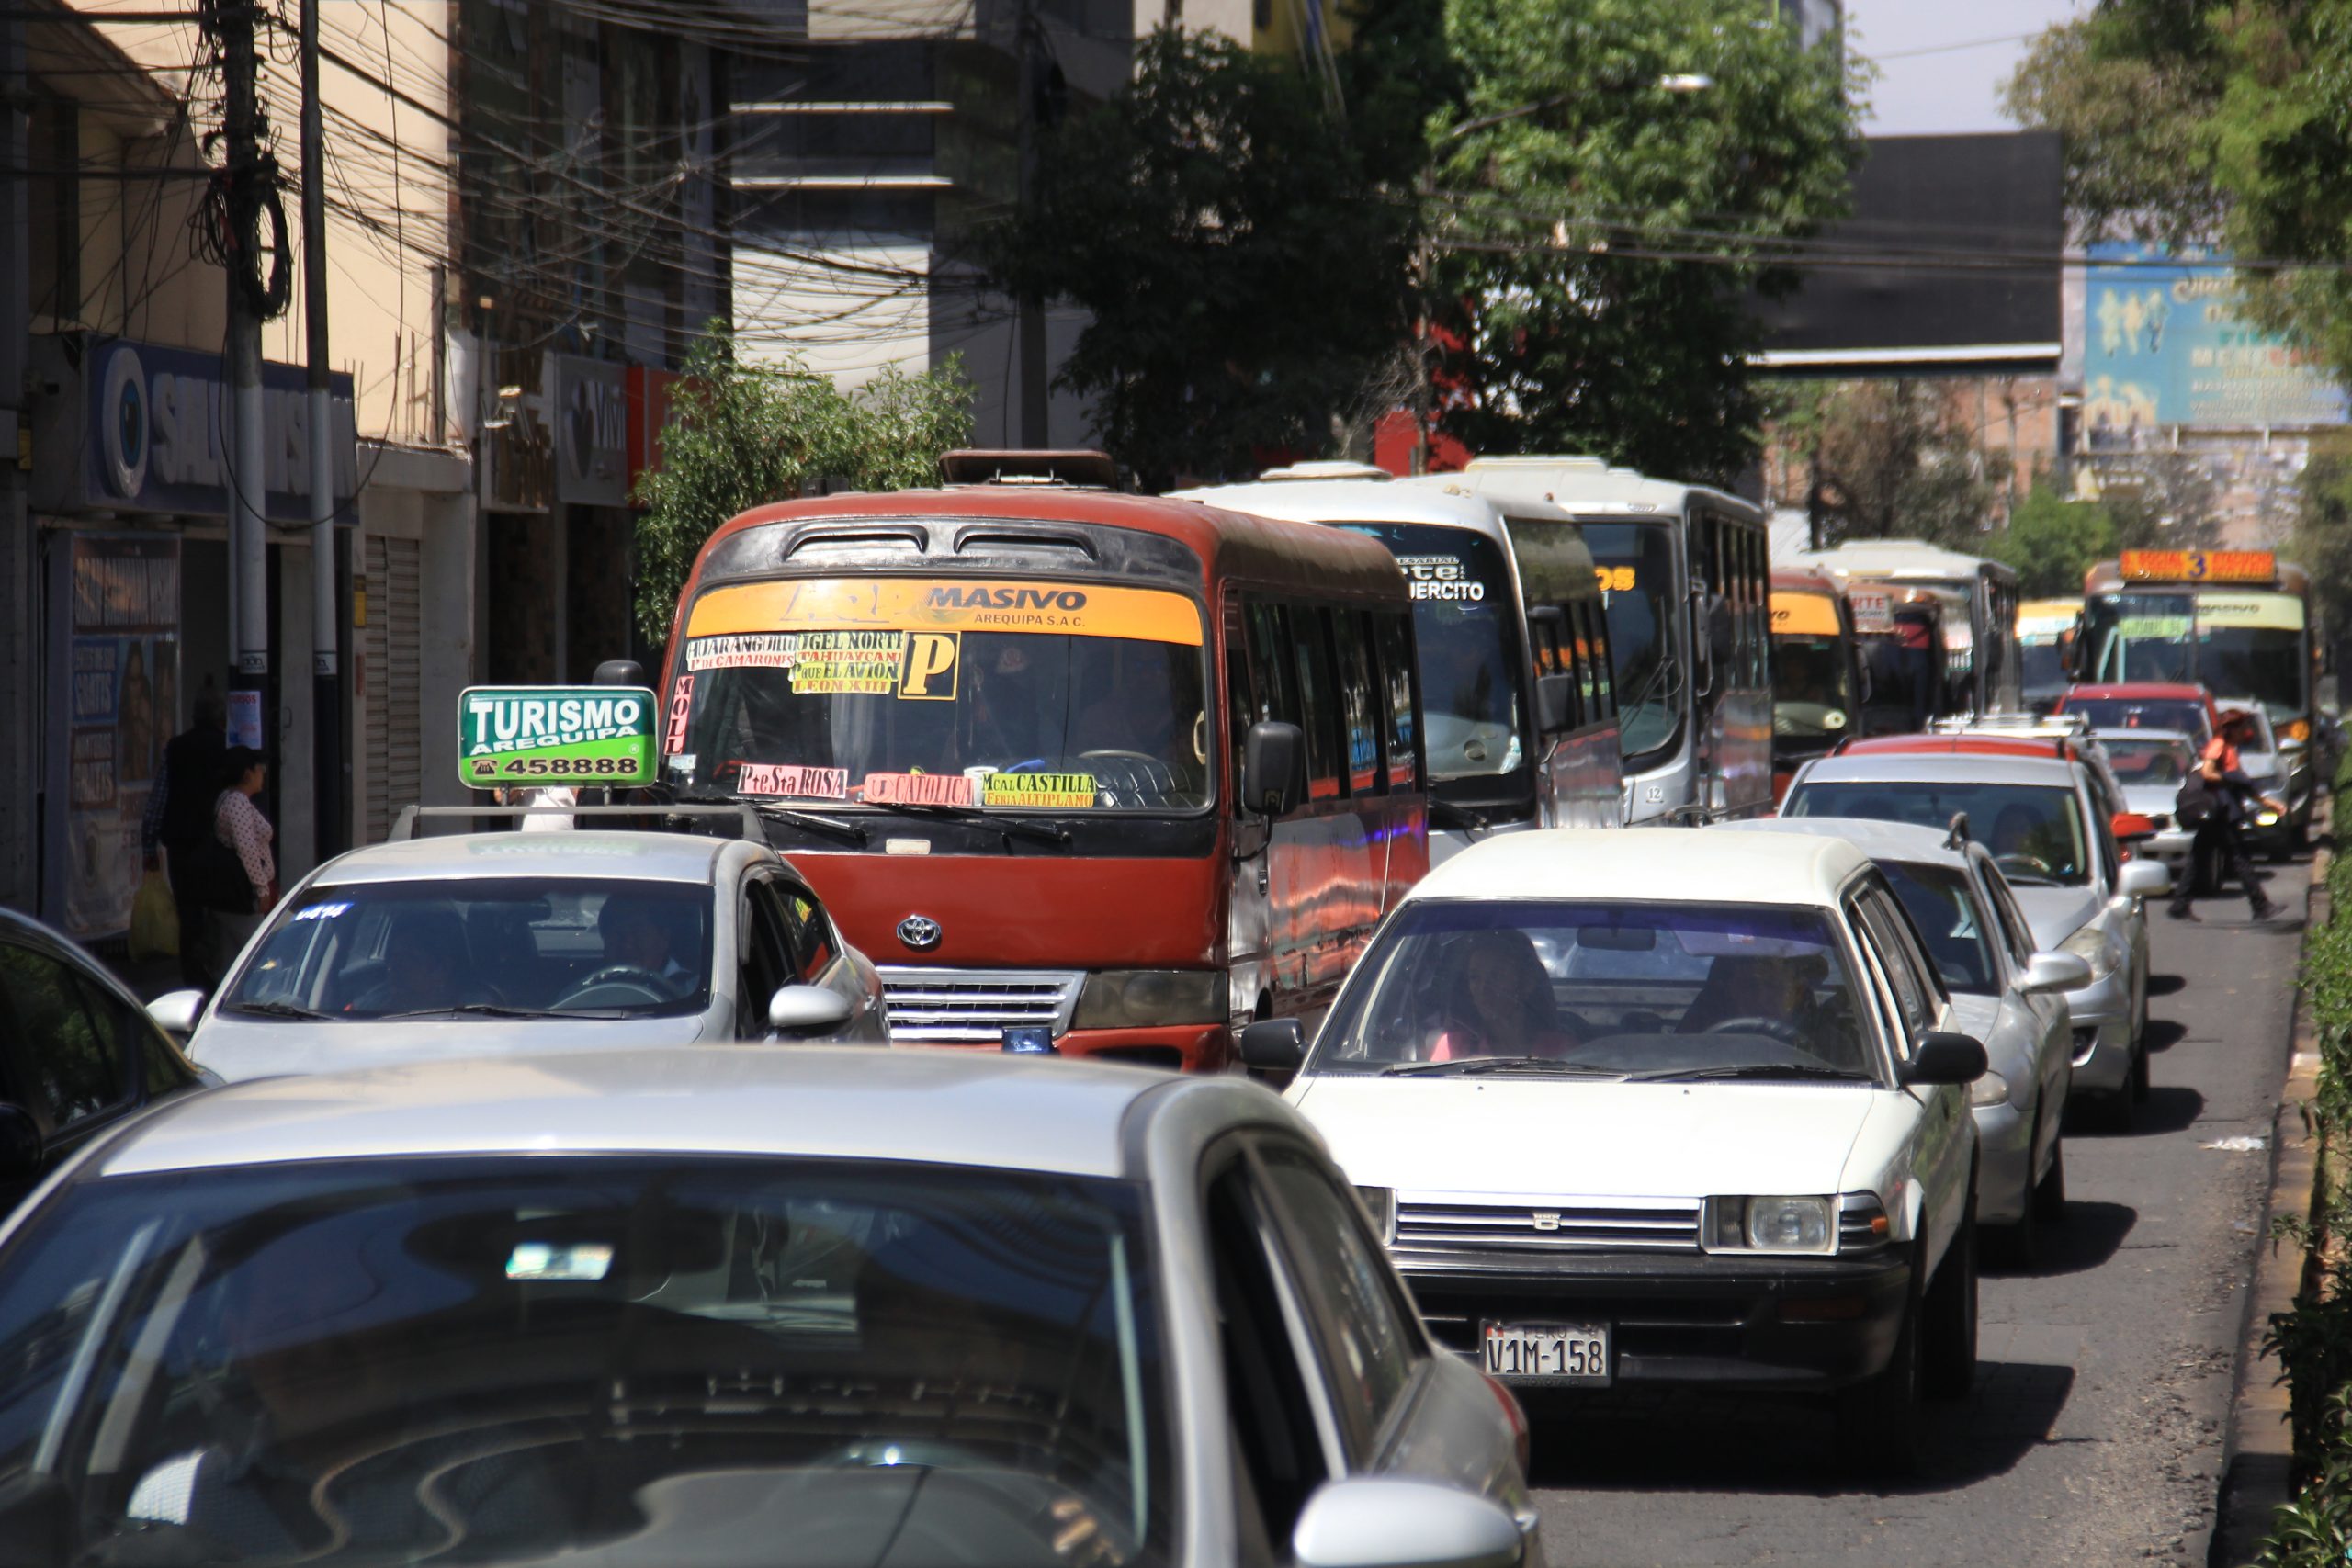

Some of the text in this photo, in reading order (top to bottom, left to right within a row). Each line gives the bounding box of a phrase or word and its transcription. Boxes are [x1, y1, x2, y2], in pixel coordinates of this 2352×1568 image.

[2188, 554, 2206, 577] 3
[927, 587, 1087, 612] MASIVO
[975, 614, 1043, 626] AREQUIPA
[717, 653, 795, 667] CAMARONES
[903, 634, 956, 694] P
[844, 663, 899, 680] AVION
[794, 680, 842, 693] LEON
[469, 700, 639, 743] TURISMO
[469, 726, 638, 756] AREQUIPA
[504, 759, 638, 774] 458888
[894, 775, 974, 805] CATOLICA
[1016, 774, 1096, 793] CASTILLA
[1649, 787, 1661, 799] 12
[1019, 793, 1093, 807] ALTIPLANO
[1488, 1339, 1603, 1374] V1M-158
